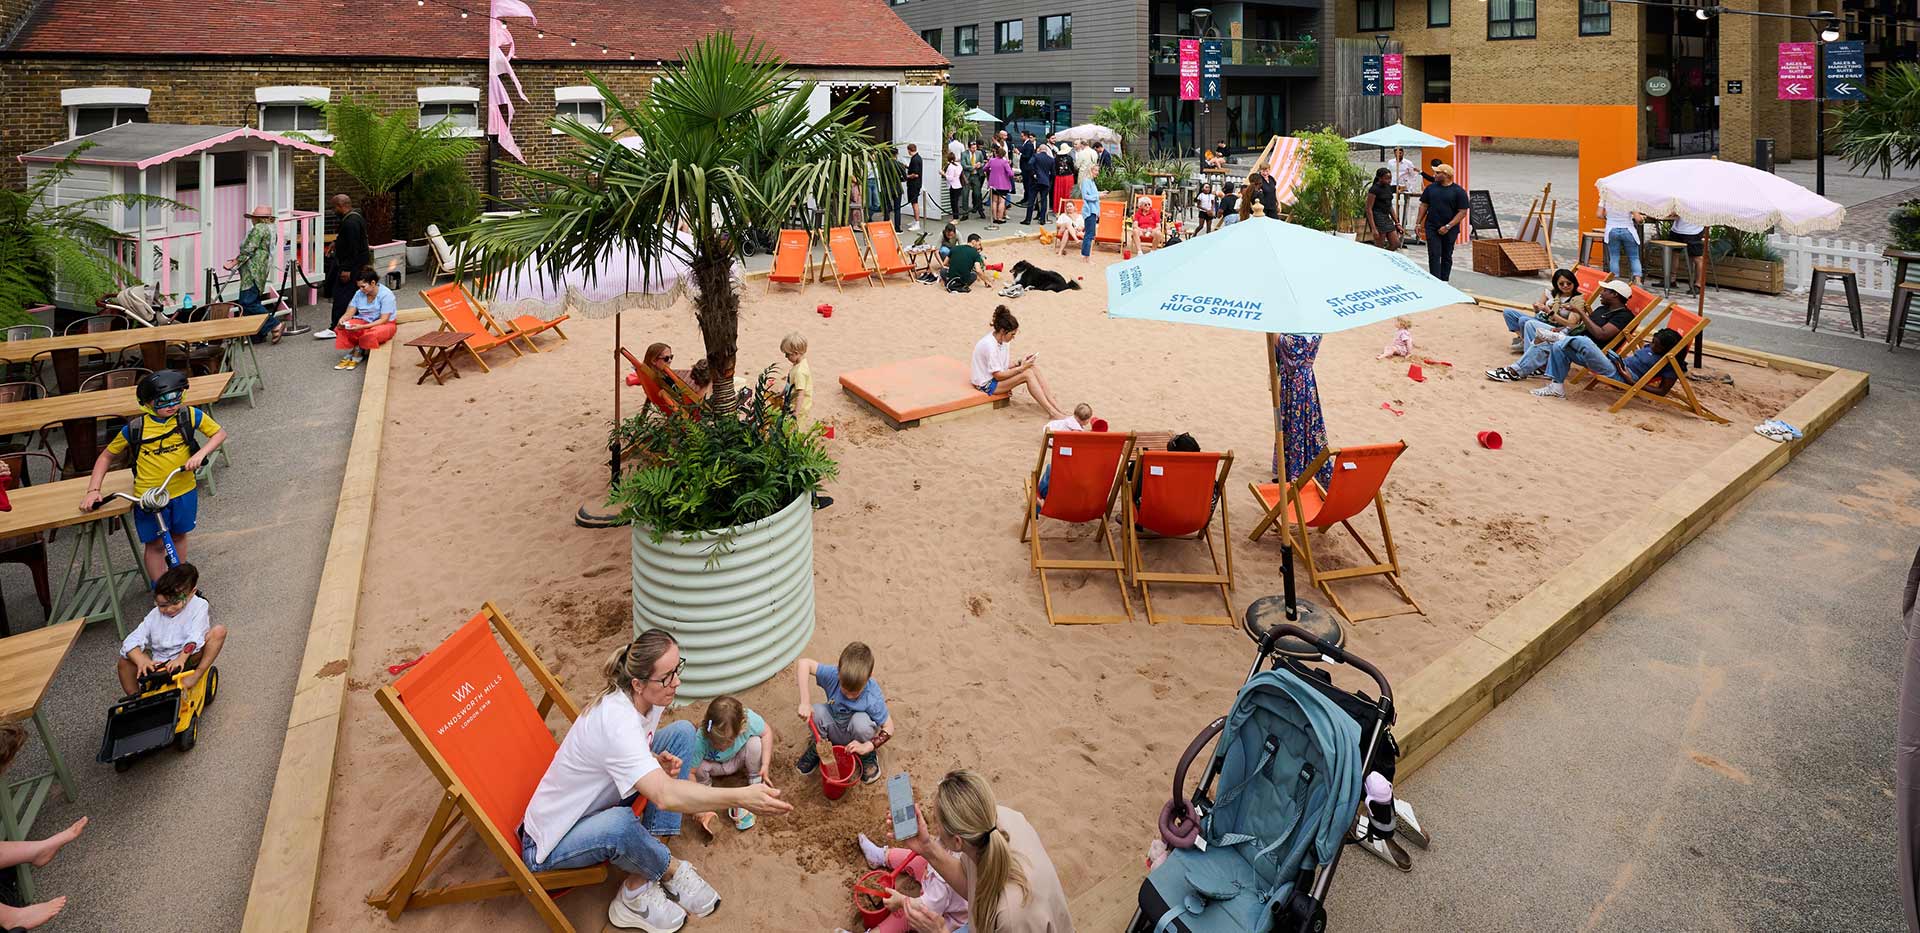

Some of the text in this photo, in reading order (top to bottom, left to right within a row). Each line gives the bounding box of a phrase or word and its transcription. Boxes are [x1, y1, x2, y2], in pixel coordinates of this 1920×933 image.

[1170, 294, 1262, 310] ST-GERMAIN
[1326, 284, 1405, 307] ST-GERMAIN
[1333, 291, 1422, 317] HUGO SPRITZ
[1160, 302, 1262, 320] HUGO SPRITZ
[437, 674, 503, 735] WANDSWORTH MILLS
[461, 710, 479, 729] LONDON
